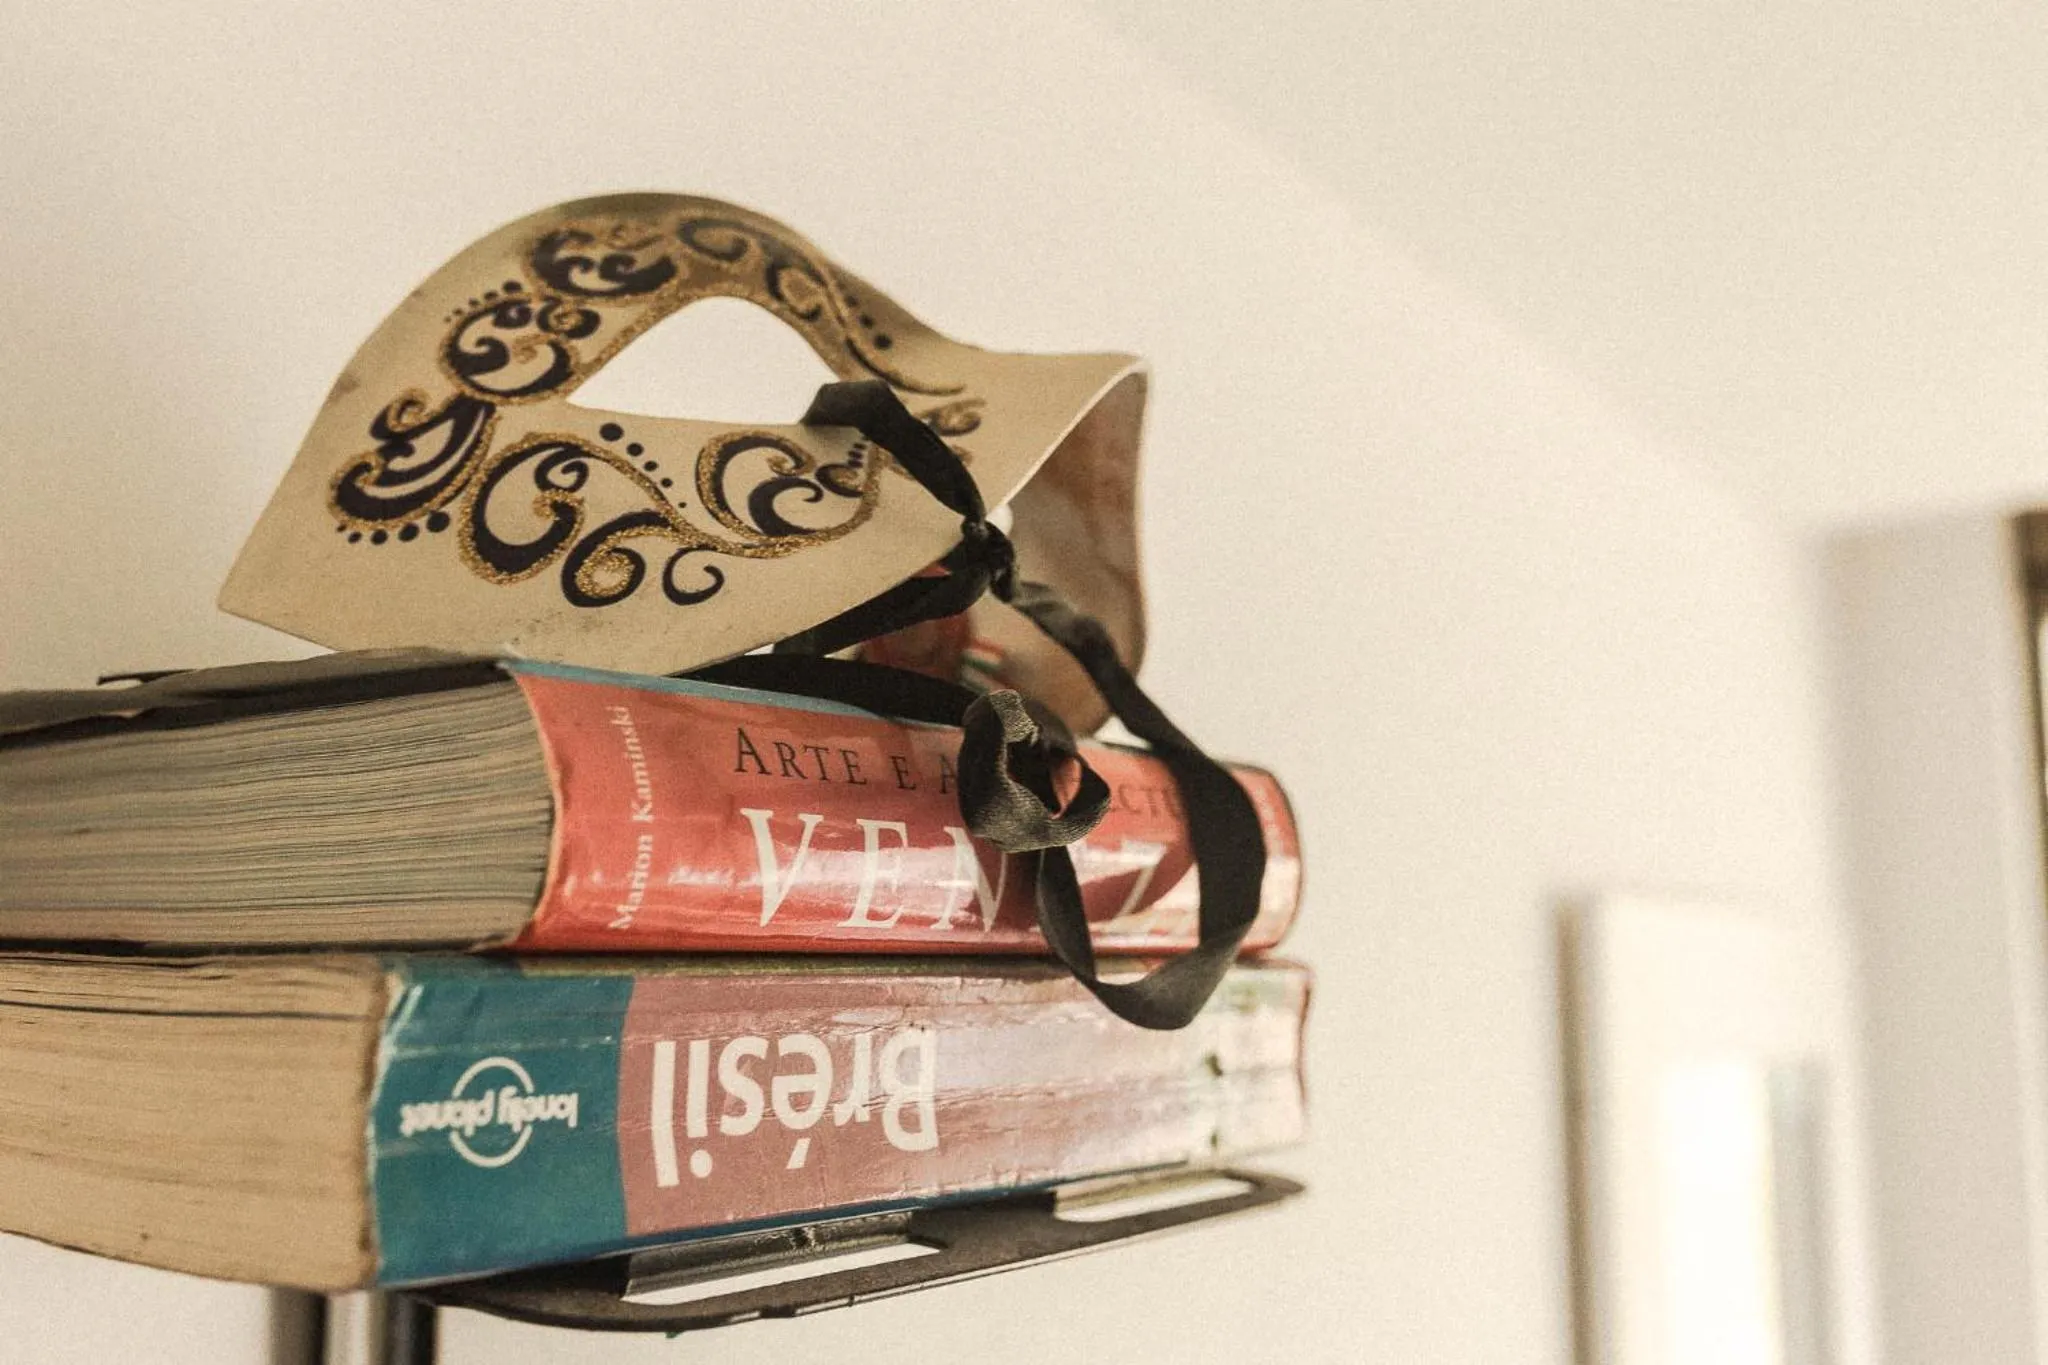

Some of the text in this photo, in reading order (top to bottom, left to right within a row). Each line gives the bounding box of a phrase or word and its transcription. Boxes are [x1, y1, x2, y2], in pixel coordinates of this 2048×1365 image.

[734, 727, 867, 785] ARTE
[891, 755, 917, 791] E
[606, 705, 655, 930] Marion Kaminski
[398, 1085, 579, 1138] lonely planet
[650, 1031, 939, 1188] Brésil
